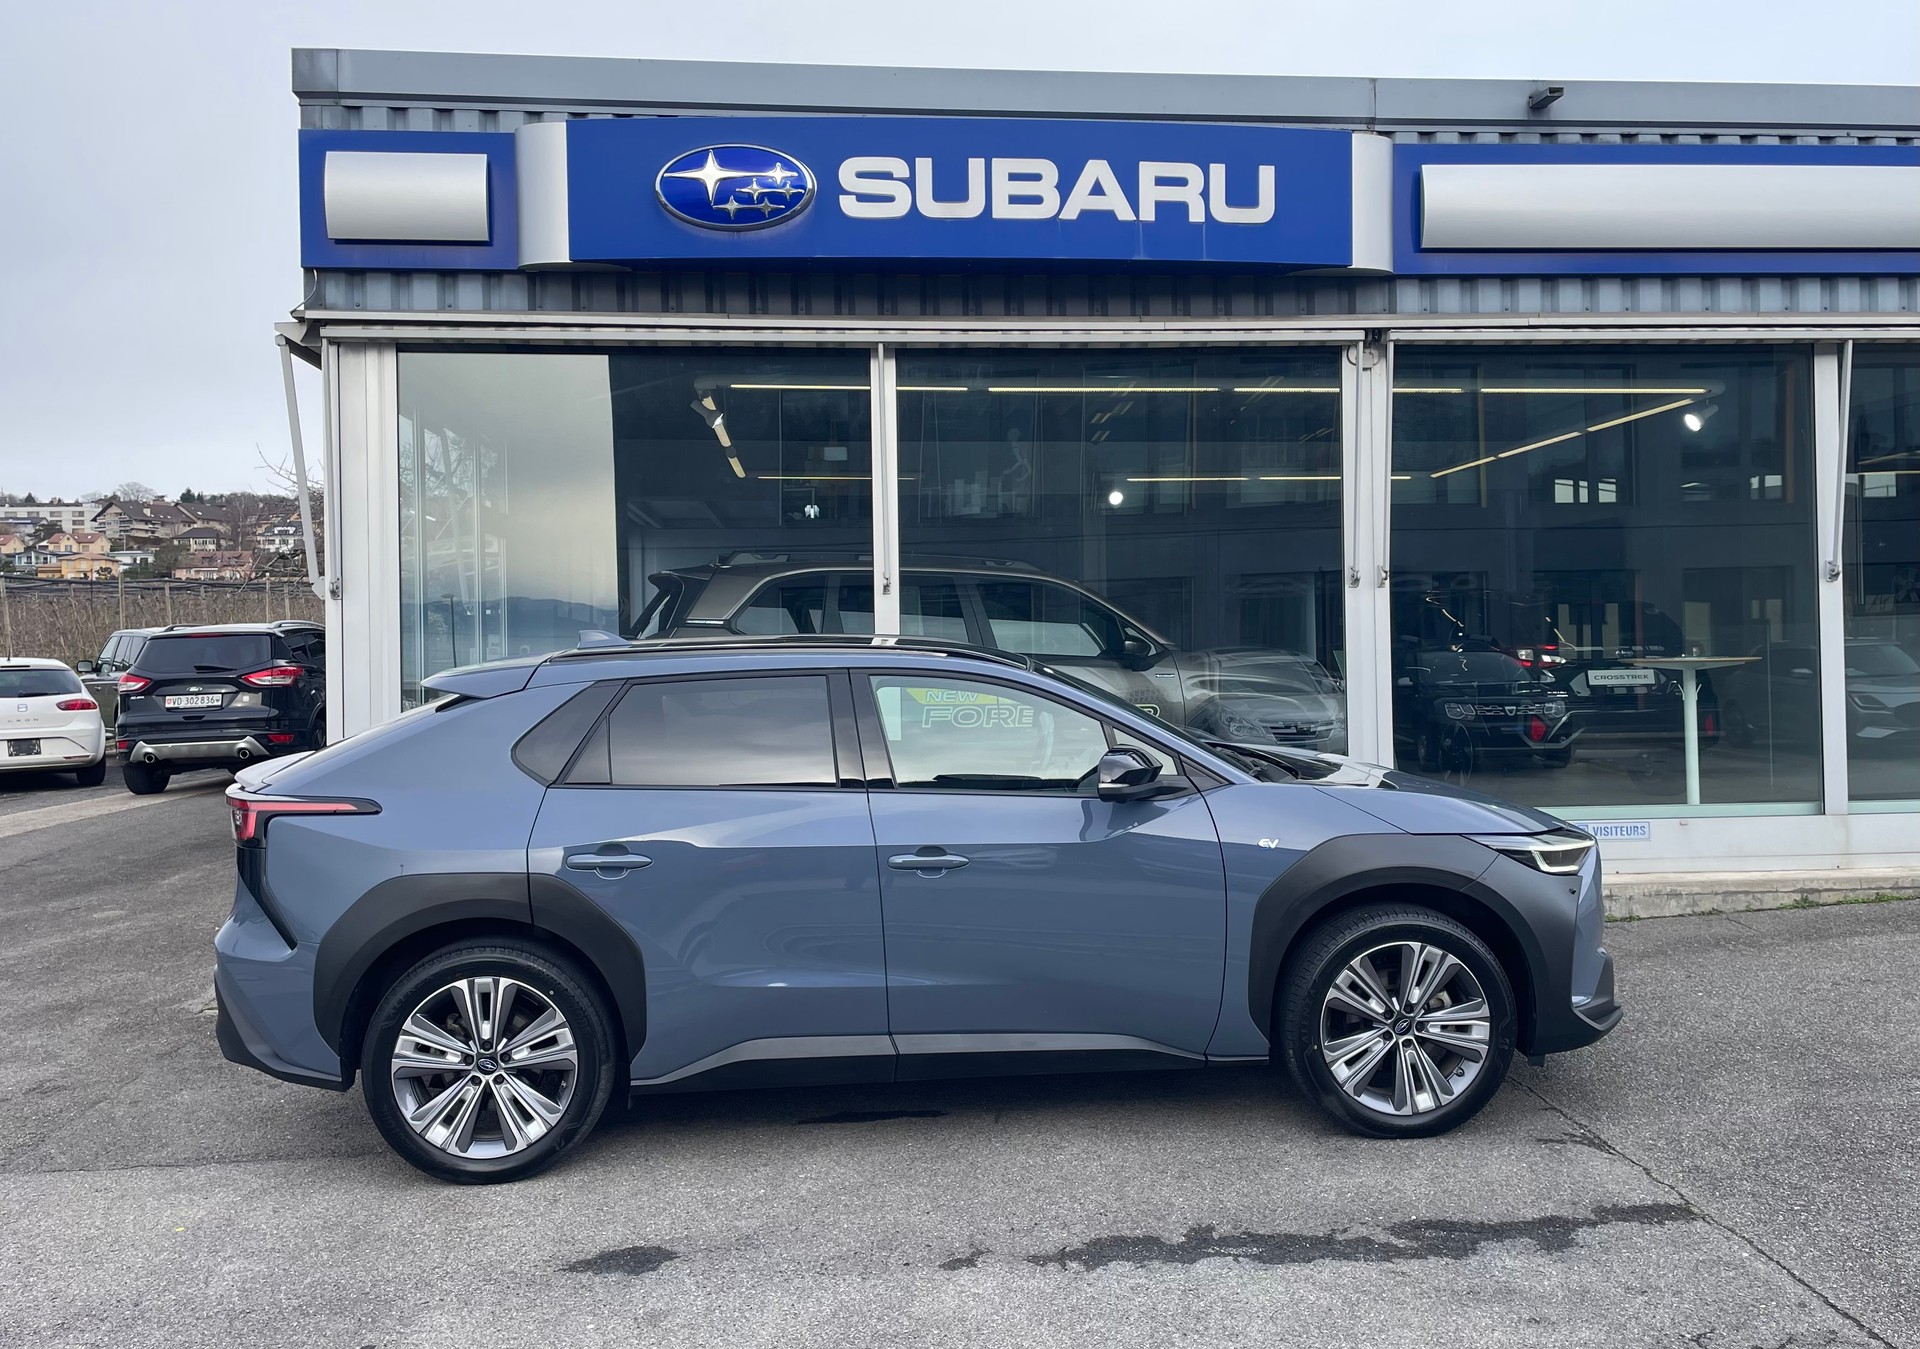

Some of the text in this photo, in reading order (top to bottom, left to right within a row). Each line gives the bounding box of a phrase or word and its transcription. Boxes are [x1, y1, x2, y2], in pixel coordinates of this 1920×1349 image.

[838, 156, 1276, 225] SUBARU
[172, 697, 182, 705] VD
[926, 690, 978, 702] NEW
[1592, 825, 1646, 837] VISITEURS
[1257, 838, 1280, 849] EV
